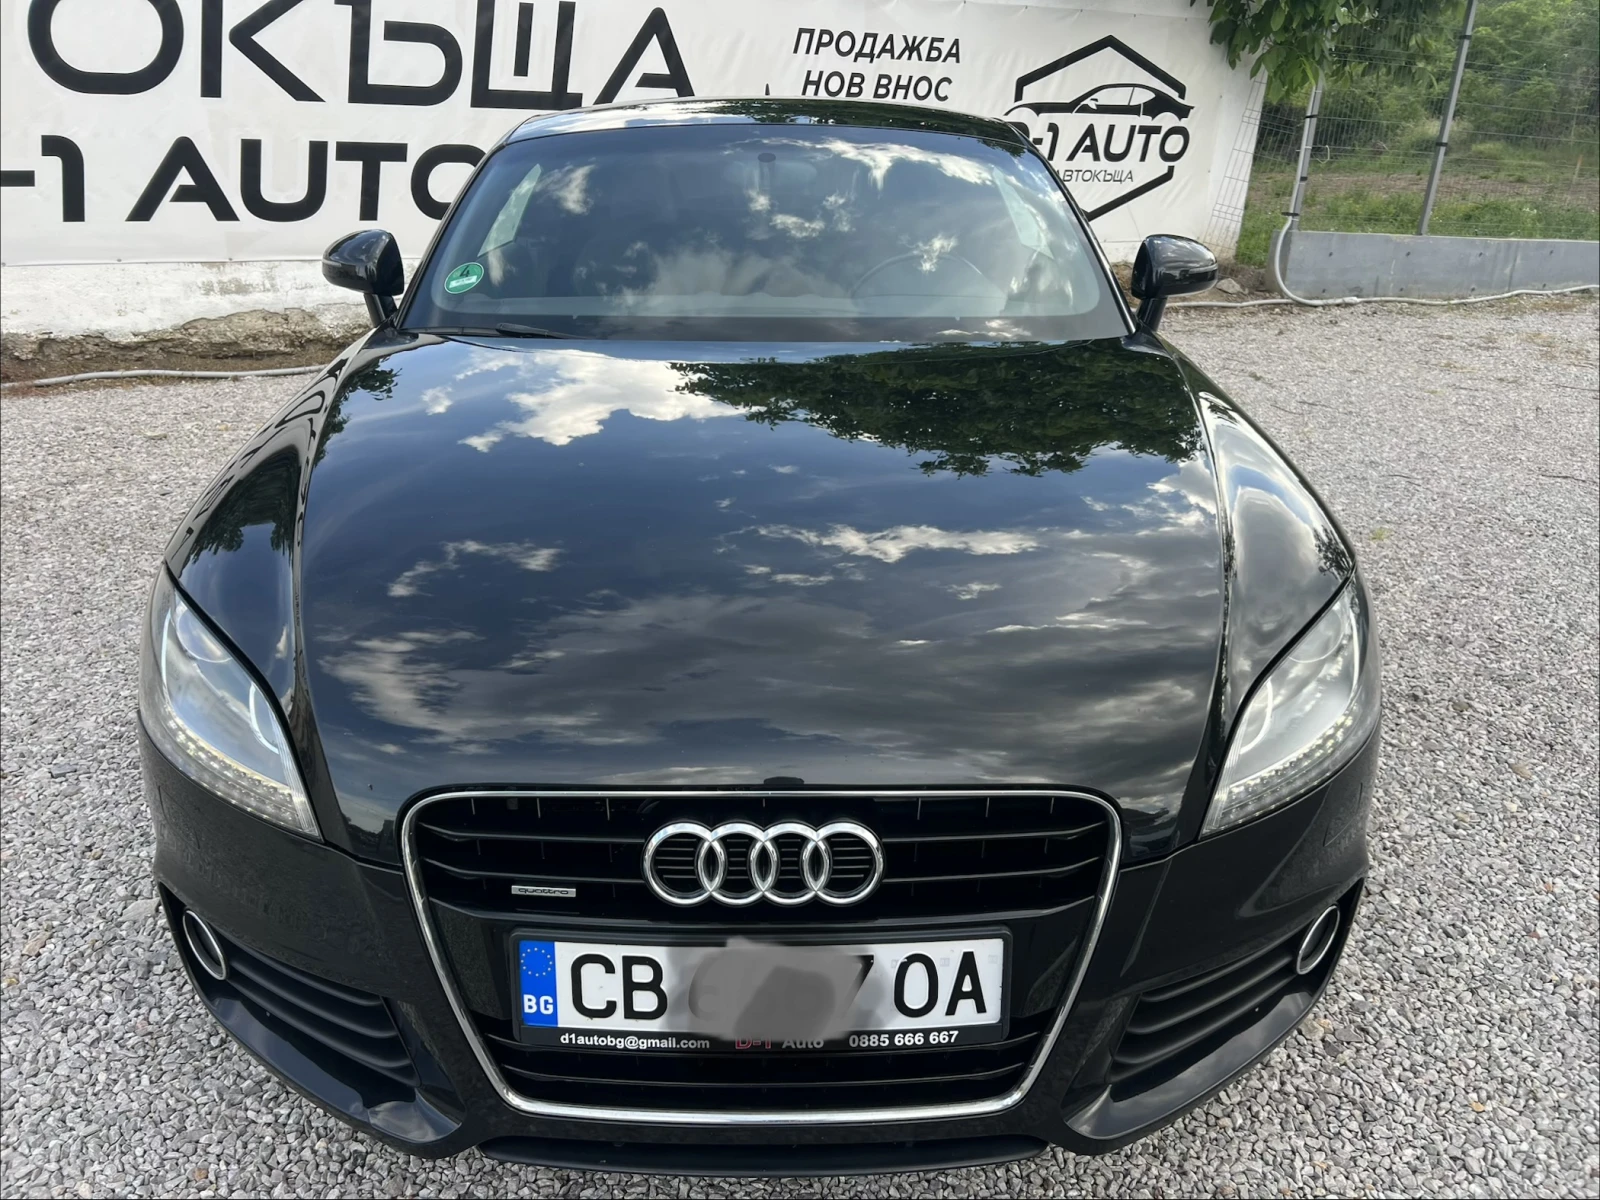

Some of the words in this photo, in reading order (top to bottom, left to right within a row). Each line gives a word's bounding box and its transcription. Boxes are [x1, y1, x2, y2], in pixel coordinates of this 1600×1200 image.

[792, 27, 961, 64] ПРОДАЖБА
[801, 70, 865, 97] НОВ
[872, 73, 953, 102] ВНОС
[1065, 123, 1190, 163] AUTO
[124, 135, 487, 222] AUTO
[459, 265, 470, 278] 4
[518, 887, 569, 895] quattro
[570, 953, 668, 1021] CB
[523, 994, 554, 1014] BG
[560, 1032, 710, 1050] d1autobg@gmail.com
[849, 1034, 890, 1047] 0885
[894, 1032, 925, 1046] 666
[929, 1030, 959, 1044] 667
